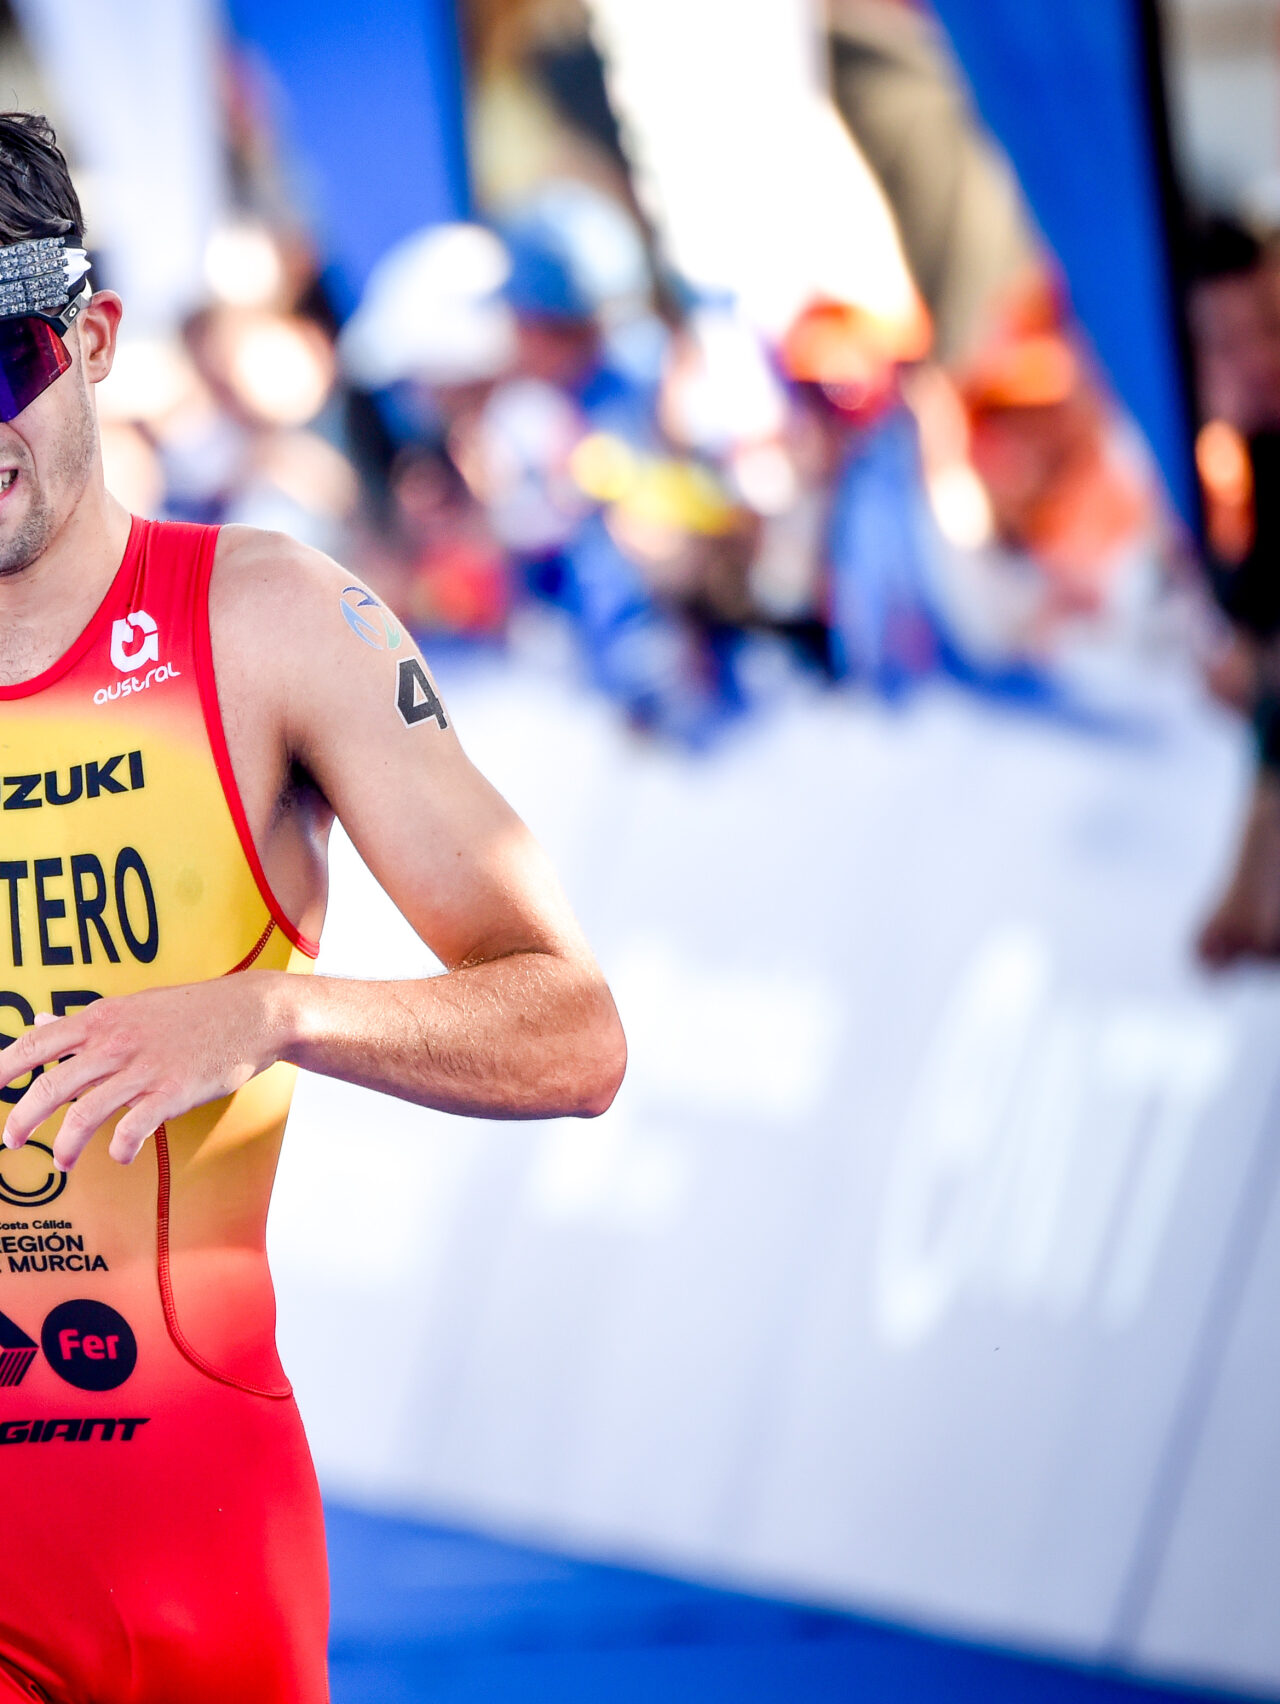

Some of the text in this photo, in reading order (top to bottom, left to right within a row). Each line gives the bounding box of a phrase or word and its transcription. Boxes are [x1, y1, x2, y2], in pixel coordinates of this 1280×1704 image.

[394, 655, 449, 730] 4
[32, 1219, 73, 1230] Cálida
[8, 1254, 110, 1274] MURCIA
[58, 1328, 120, 1361] Fer
